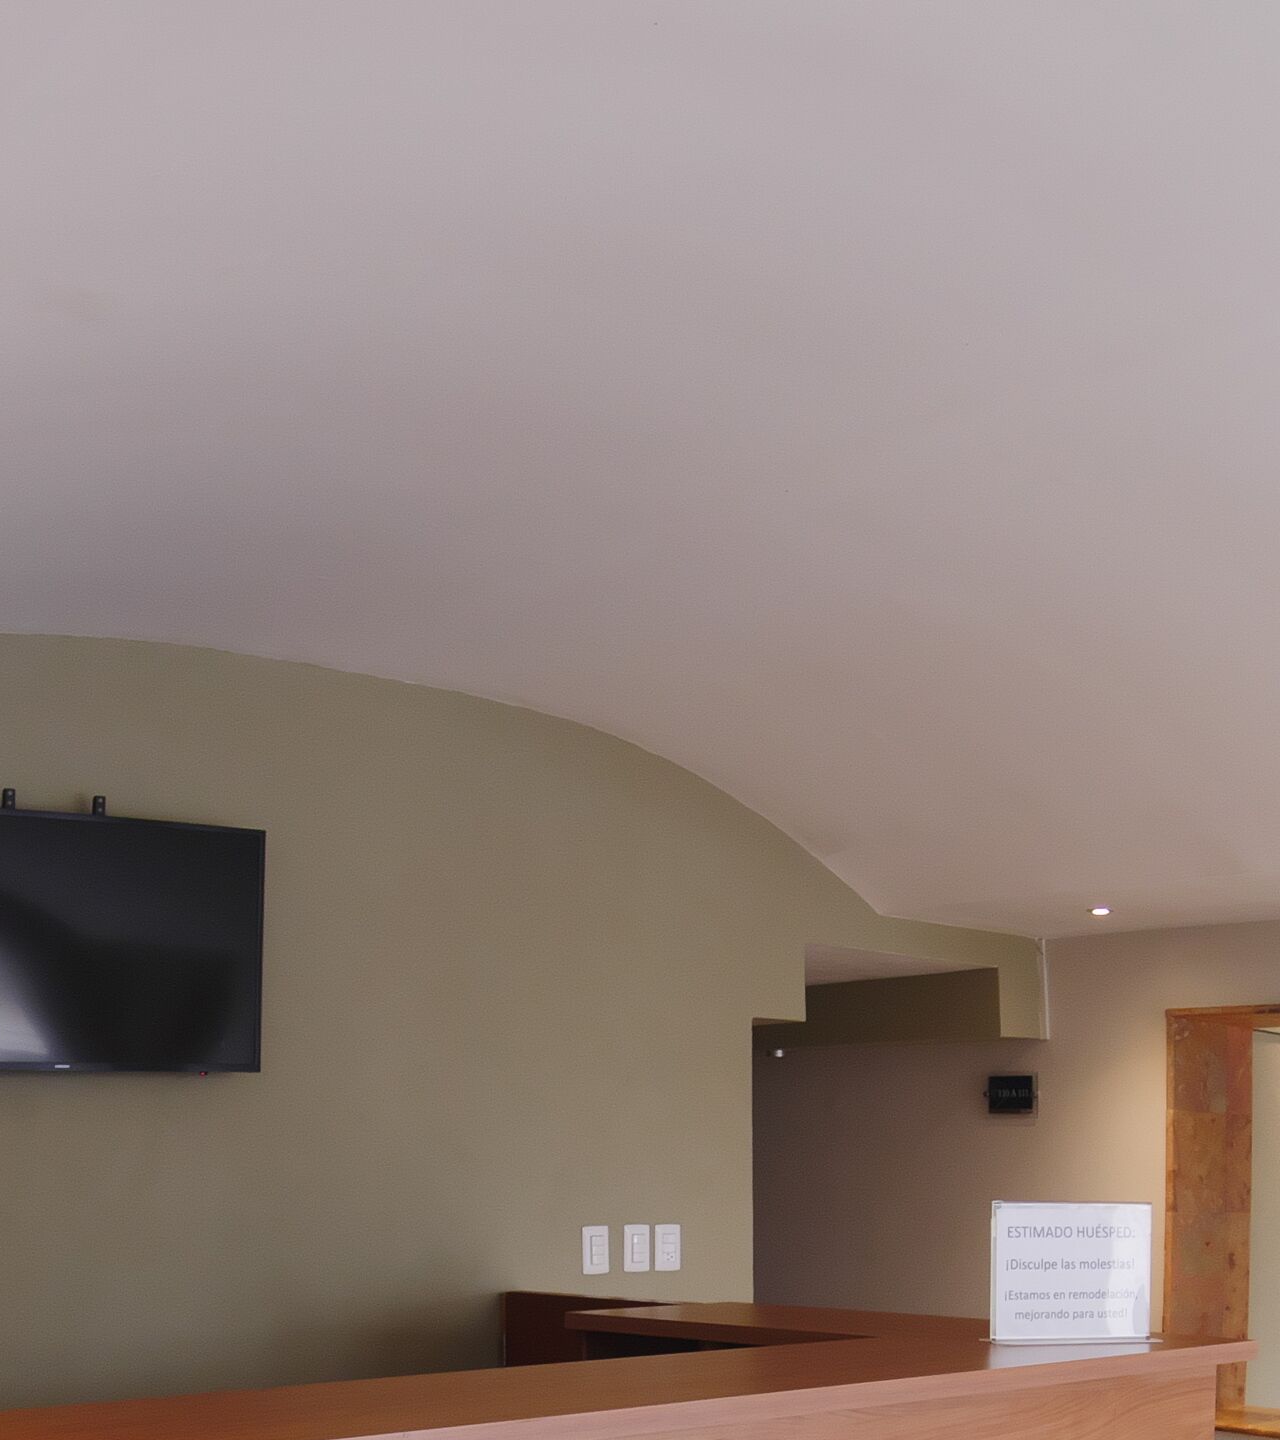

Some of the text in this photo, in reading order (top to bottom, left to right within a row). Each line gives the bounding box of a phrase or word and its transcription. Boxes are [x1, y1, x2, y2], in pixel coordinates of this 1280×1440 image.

[1007, 1226, 1073, 1239] ESTIMADO
[1005, 1257, 1135, 1272] ¡Disculpe las molestias!
[1004, 1289, 1051, 1302] ¡Estamos
[1053, 1291, 1066, 1300] en
[1014, 1308, 1128, 1322] mejorando para usted!
